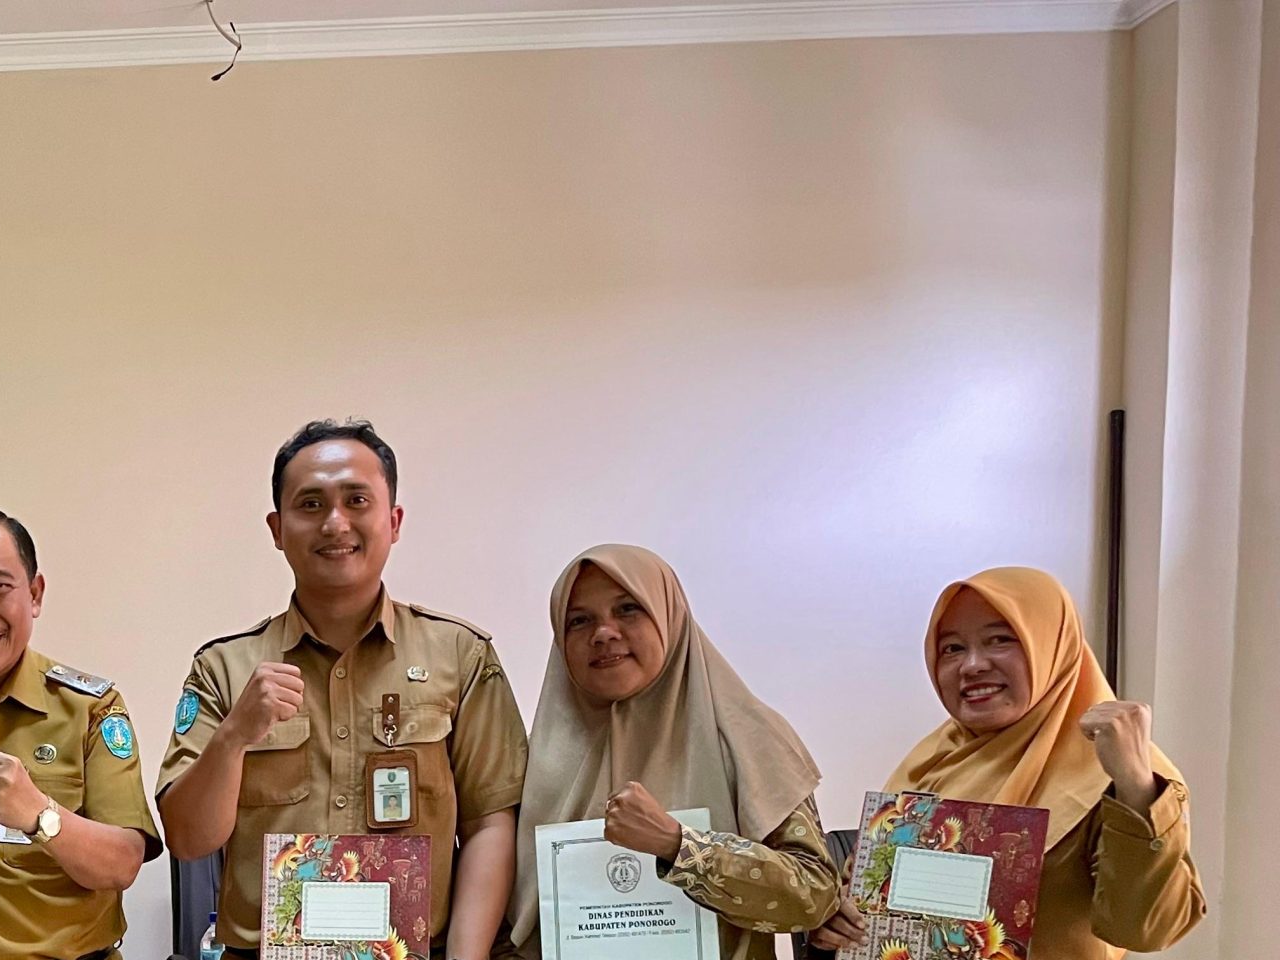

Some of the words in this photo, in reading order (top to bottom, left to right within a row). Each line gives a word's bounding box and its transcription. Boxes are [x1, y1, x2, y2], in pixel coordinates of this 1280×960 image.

[588, 911, 613, 920] DINAS
[614, 908, 664, 919] PENDIDIKAN
[578, 921, 626, 931] KABUPATEN
[628, 919, 676, 930] PONOROGO
